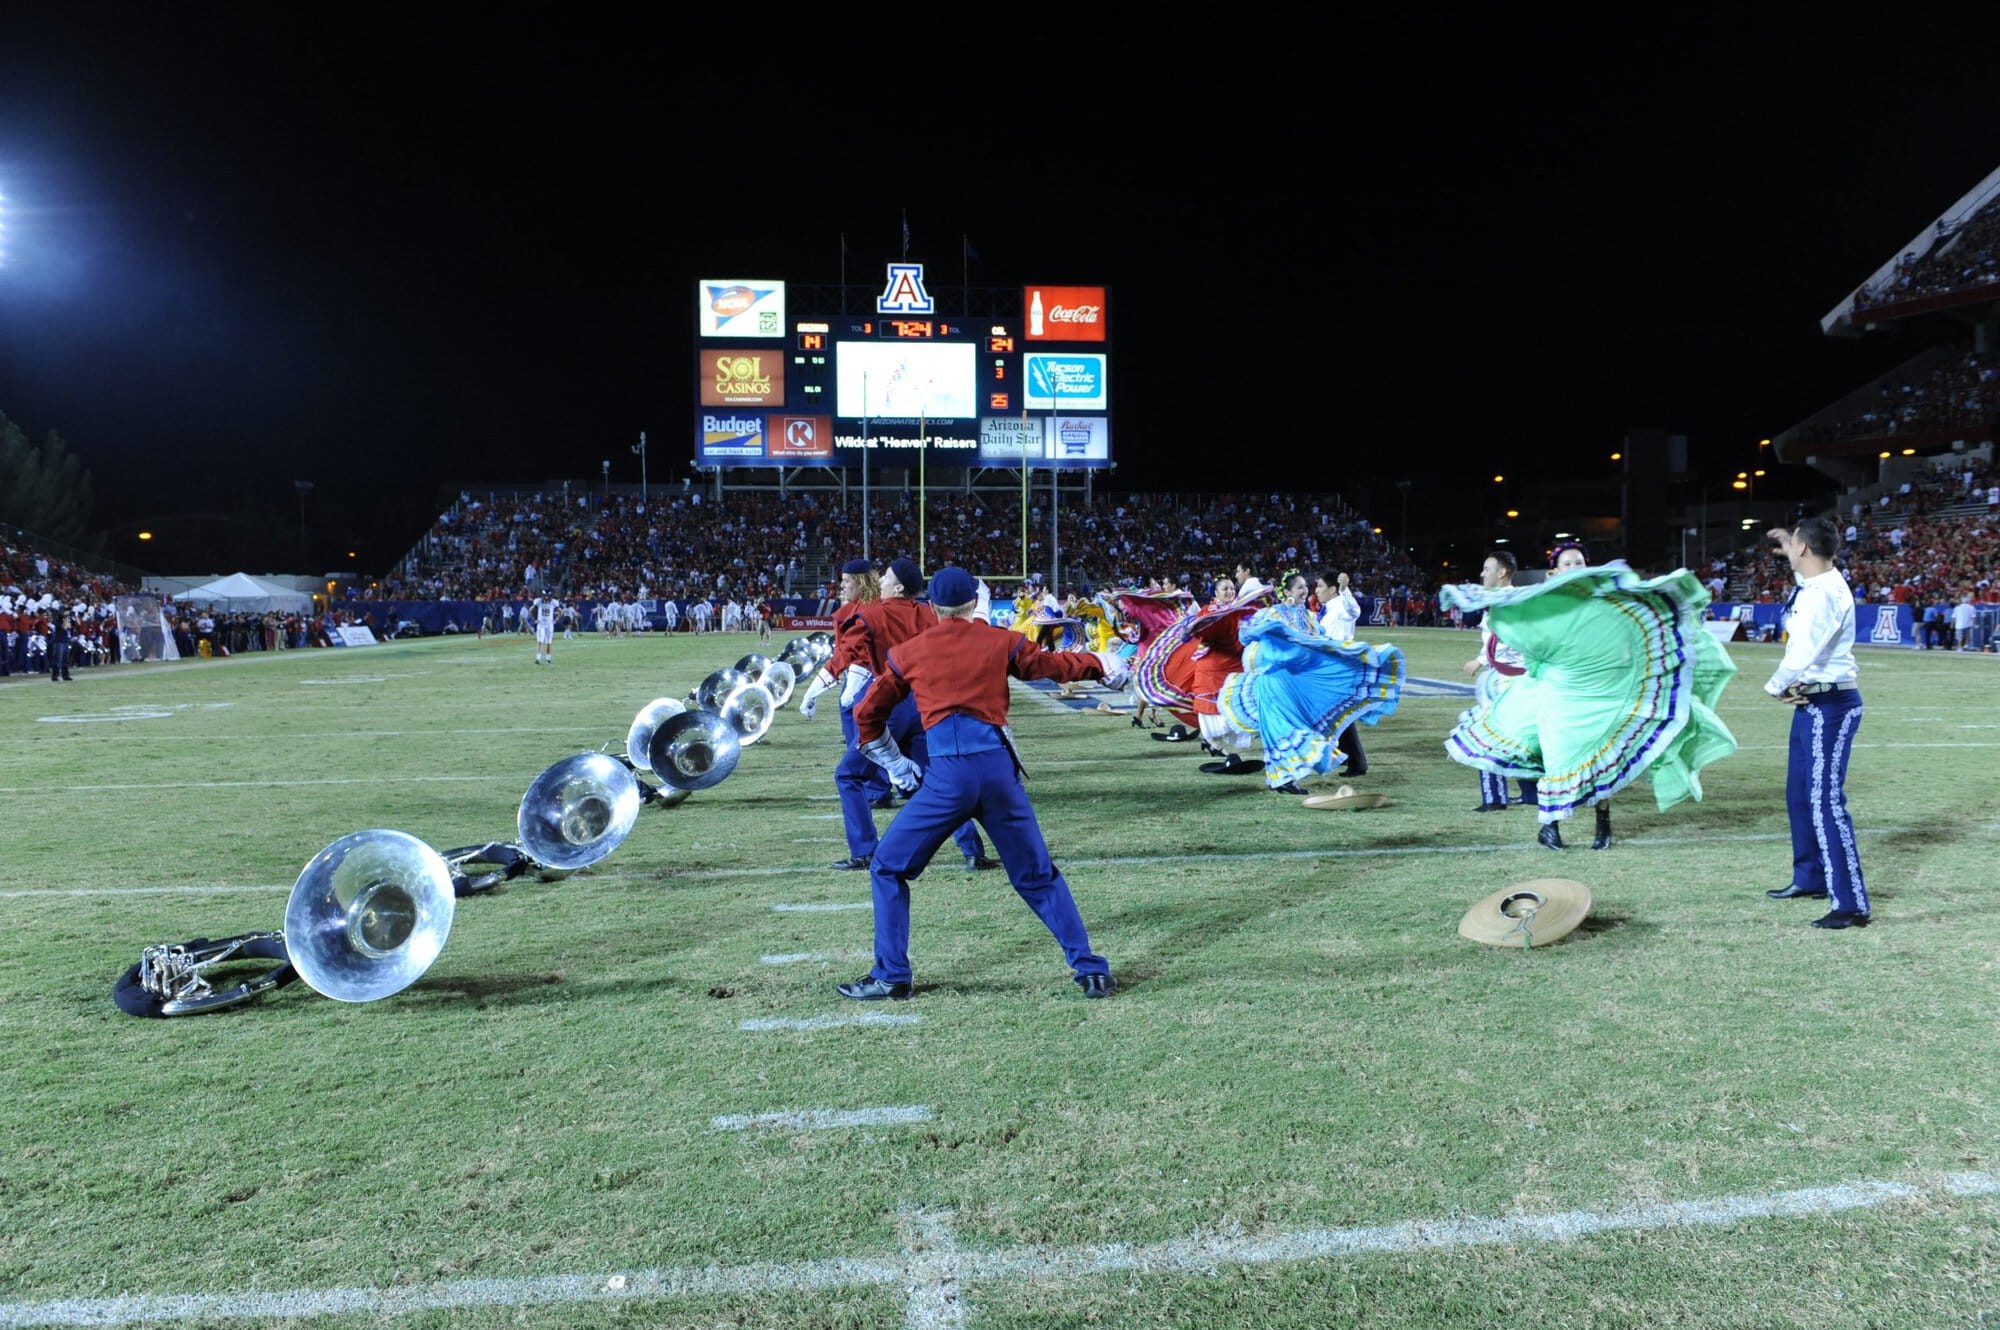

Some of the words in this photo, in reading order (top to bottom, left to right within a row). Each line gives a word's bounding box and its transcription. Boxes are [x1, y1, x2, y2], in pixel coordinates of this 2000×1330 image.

[877, 263, 934, 314] A
[1049, 305, 1100, 323] Coca-Cola
[864, 323, 872, 334] 3
[892, 321, 932, 337] 7:24
[940, 324, 948, 335] 3
[991, 337, 1013, 351] 24
[716, 356, 771, 382] SOL
[995, 367, 1004, 379] 3
[1046, 361, 1085, 373] Tucson
[1051, 373, 1095, 383] Electric
[716, 382, 771, 394] CASINOS
[1055, 382, 1095, 393] Power
[704, 415, 762, 436] Budget
[835, 436, 878, 448] Wildcat
[934, 436, 977, 448] Raisers
[981, 432, 1013, 447] Daily
[1016, 432, 1041, 445] Star
[791, 619, 804, 627] Go
[805, 619, 833, 627] Wildca
[1871, 605, 1901, 643] A
